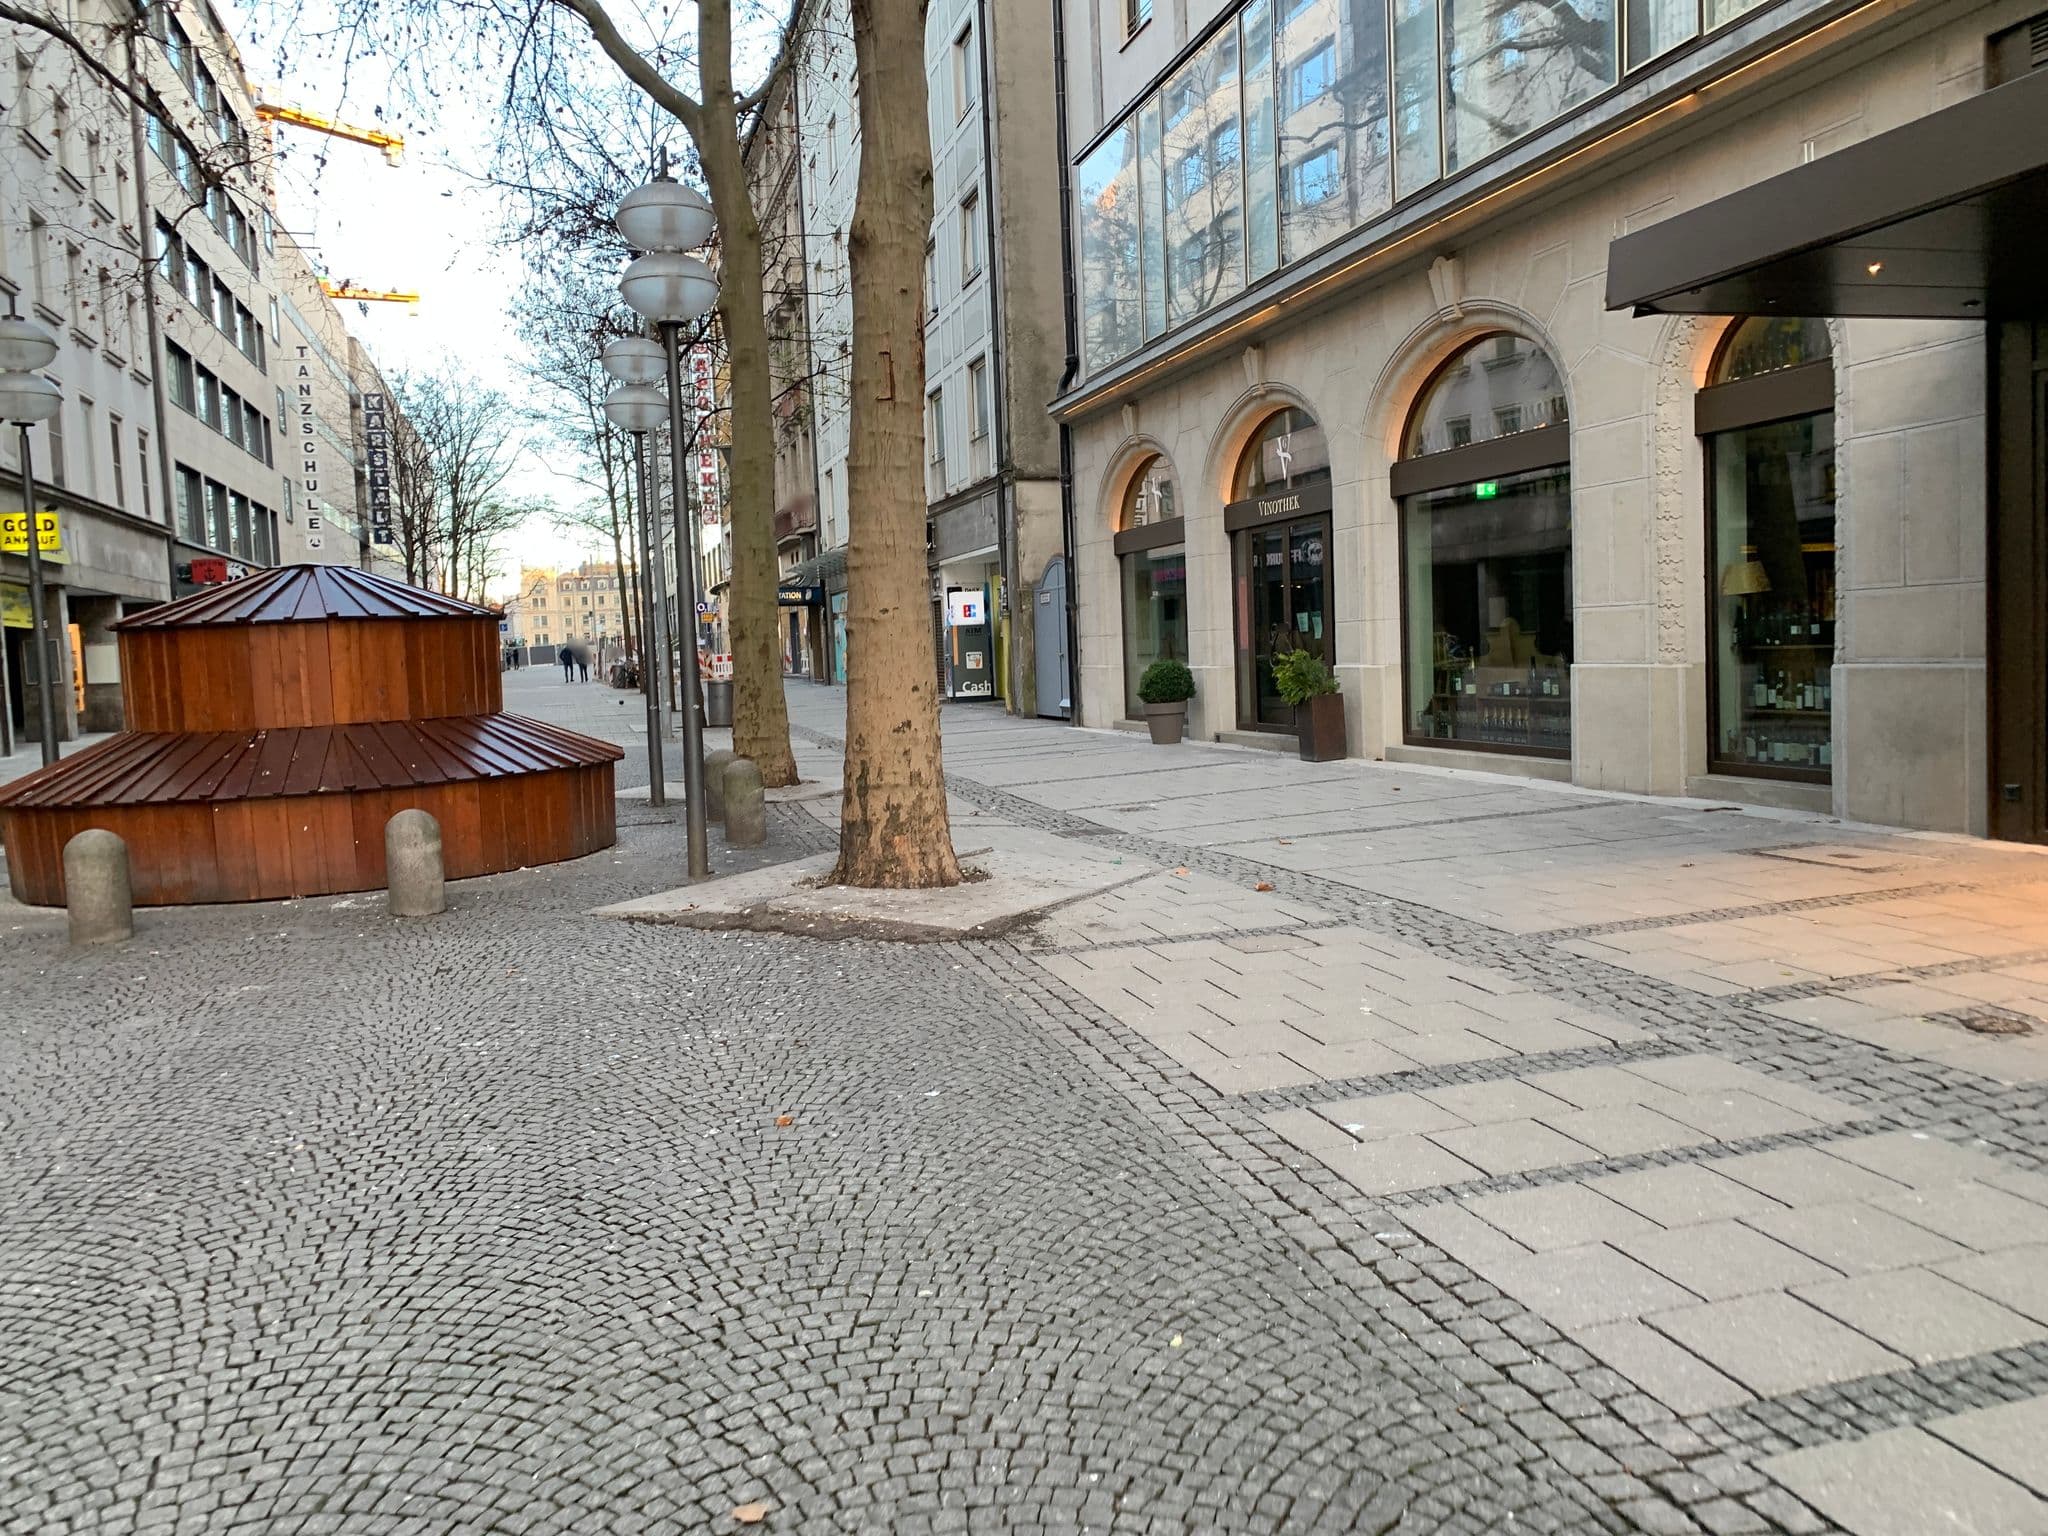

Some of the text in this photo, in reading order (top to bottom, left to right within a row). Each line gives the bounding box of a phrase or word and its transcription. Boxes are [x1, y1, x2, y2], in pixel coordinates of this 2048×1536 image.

[295, 346, 320, 529] TANZSCHULE
[1258, 494, 1301, 517] VINOTHEK
[4, 535, 56, 545] ANKUF
[962, 680, 992, 693] Cash
